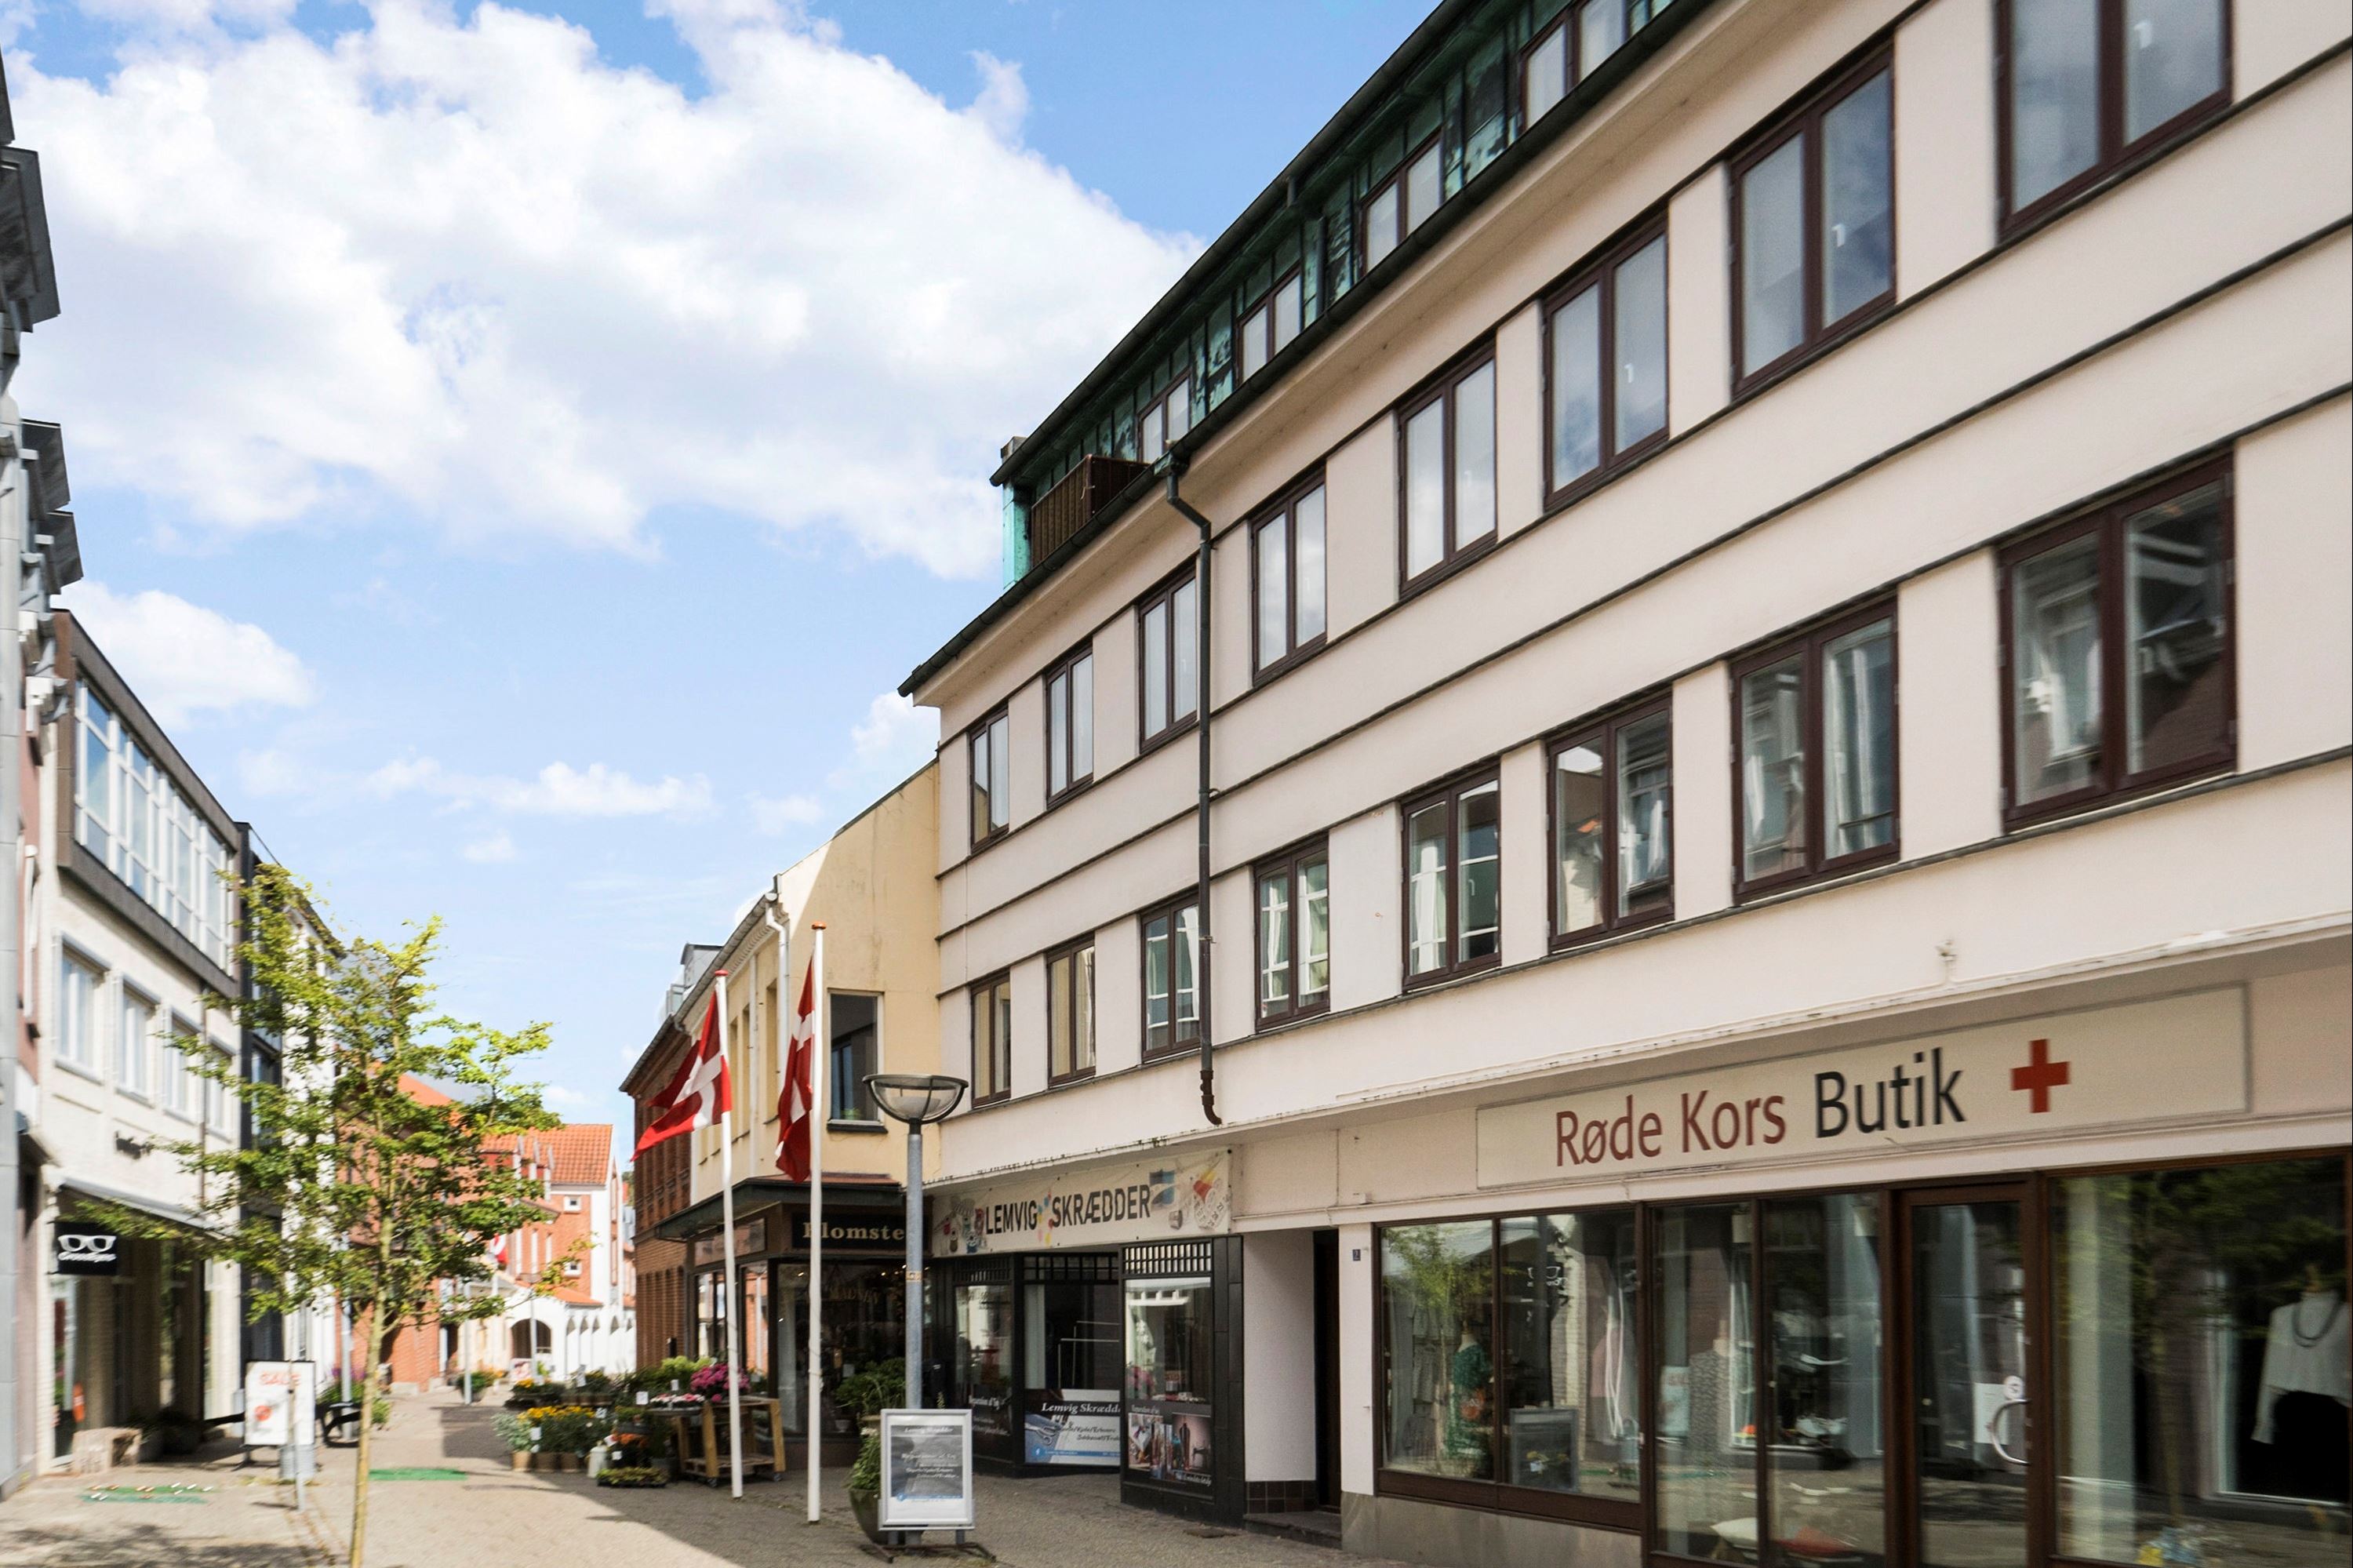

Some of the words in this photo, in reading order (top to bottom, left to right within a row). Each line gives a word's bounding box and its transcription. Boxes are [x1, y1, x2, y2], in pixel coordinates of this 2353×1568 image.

[1555, 1094, 1662, 1167] Røde
[1681, 1090, 1786, 1153] Kors
[1814, 1046, 1966, 1139] Butik
[985, 1199, 1038, 1235] LEMVIG
[1052, 1184, 1151, 1228] SKRÆDDER
[1042, 1402, 1078, 1414] Lemvig
